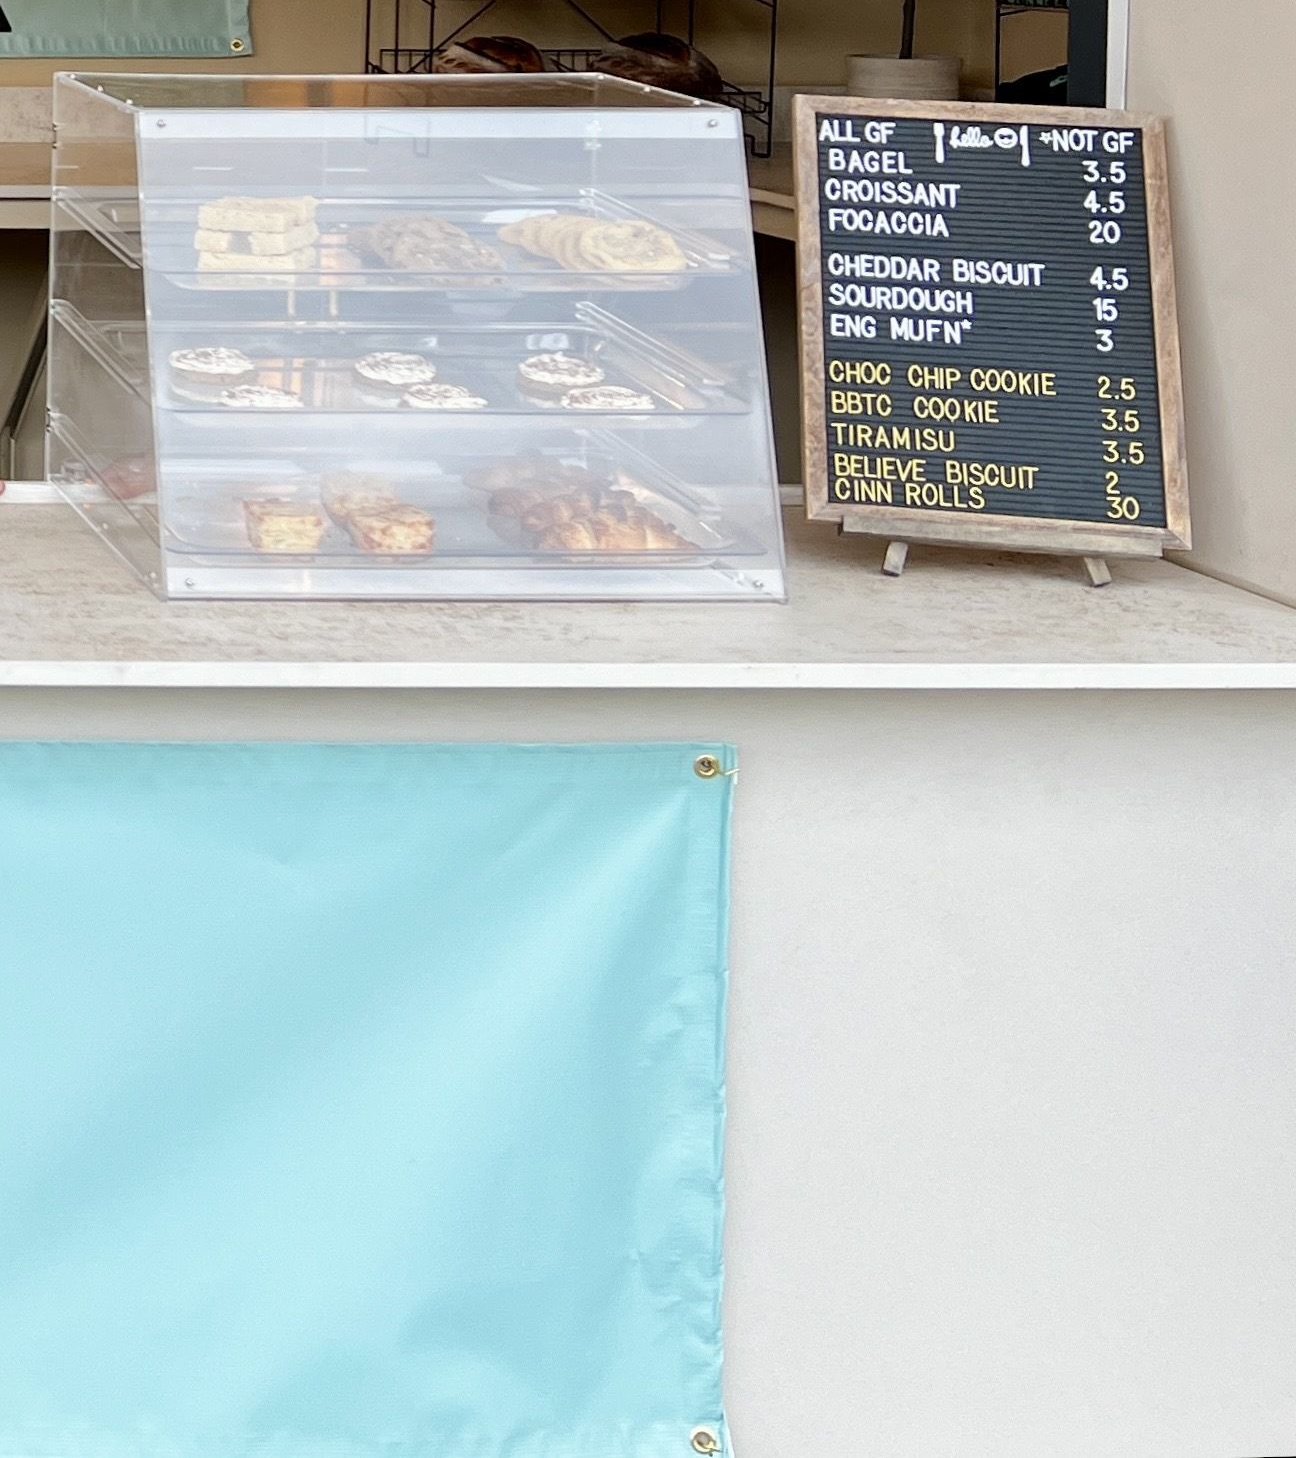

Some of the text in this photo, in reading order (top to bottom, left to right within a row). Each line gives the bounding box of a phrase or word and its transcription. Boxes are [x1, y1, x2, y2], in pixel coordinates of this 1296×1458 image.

[819, 120, 896, 143] ALL GF
[1102, 131, 1134, 154] GF
[828, 148, 1127, 184] BAGEL 3.5
[824, 177, 1126, 215] CROISSANT 4.5
[827, 208, 1122, 244] FOCACCIA 20
[827, 253, 1129, 291] CHEDDAR BISCUIT 4.5
[828, 283, 1119, 322] SOURDOUGH 15
[830, 313, 876, 339] ENG
[1094, 328, 1114, 353] 3
[828, 360, 1137, 401] CHOC CHIP COOKIE 2.5
[831, 392, 1140, 433] BBTC COOKIE 3.5
[830, 423, 1146, 465] TIRAMISU 3.5
[833, 454, 1121, 496] BELIEVE BISCUIT 2
[834, 478, 1141, 520] CINN ROLLS 30
